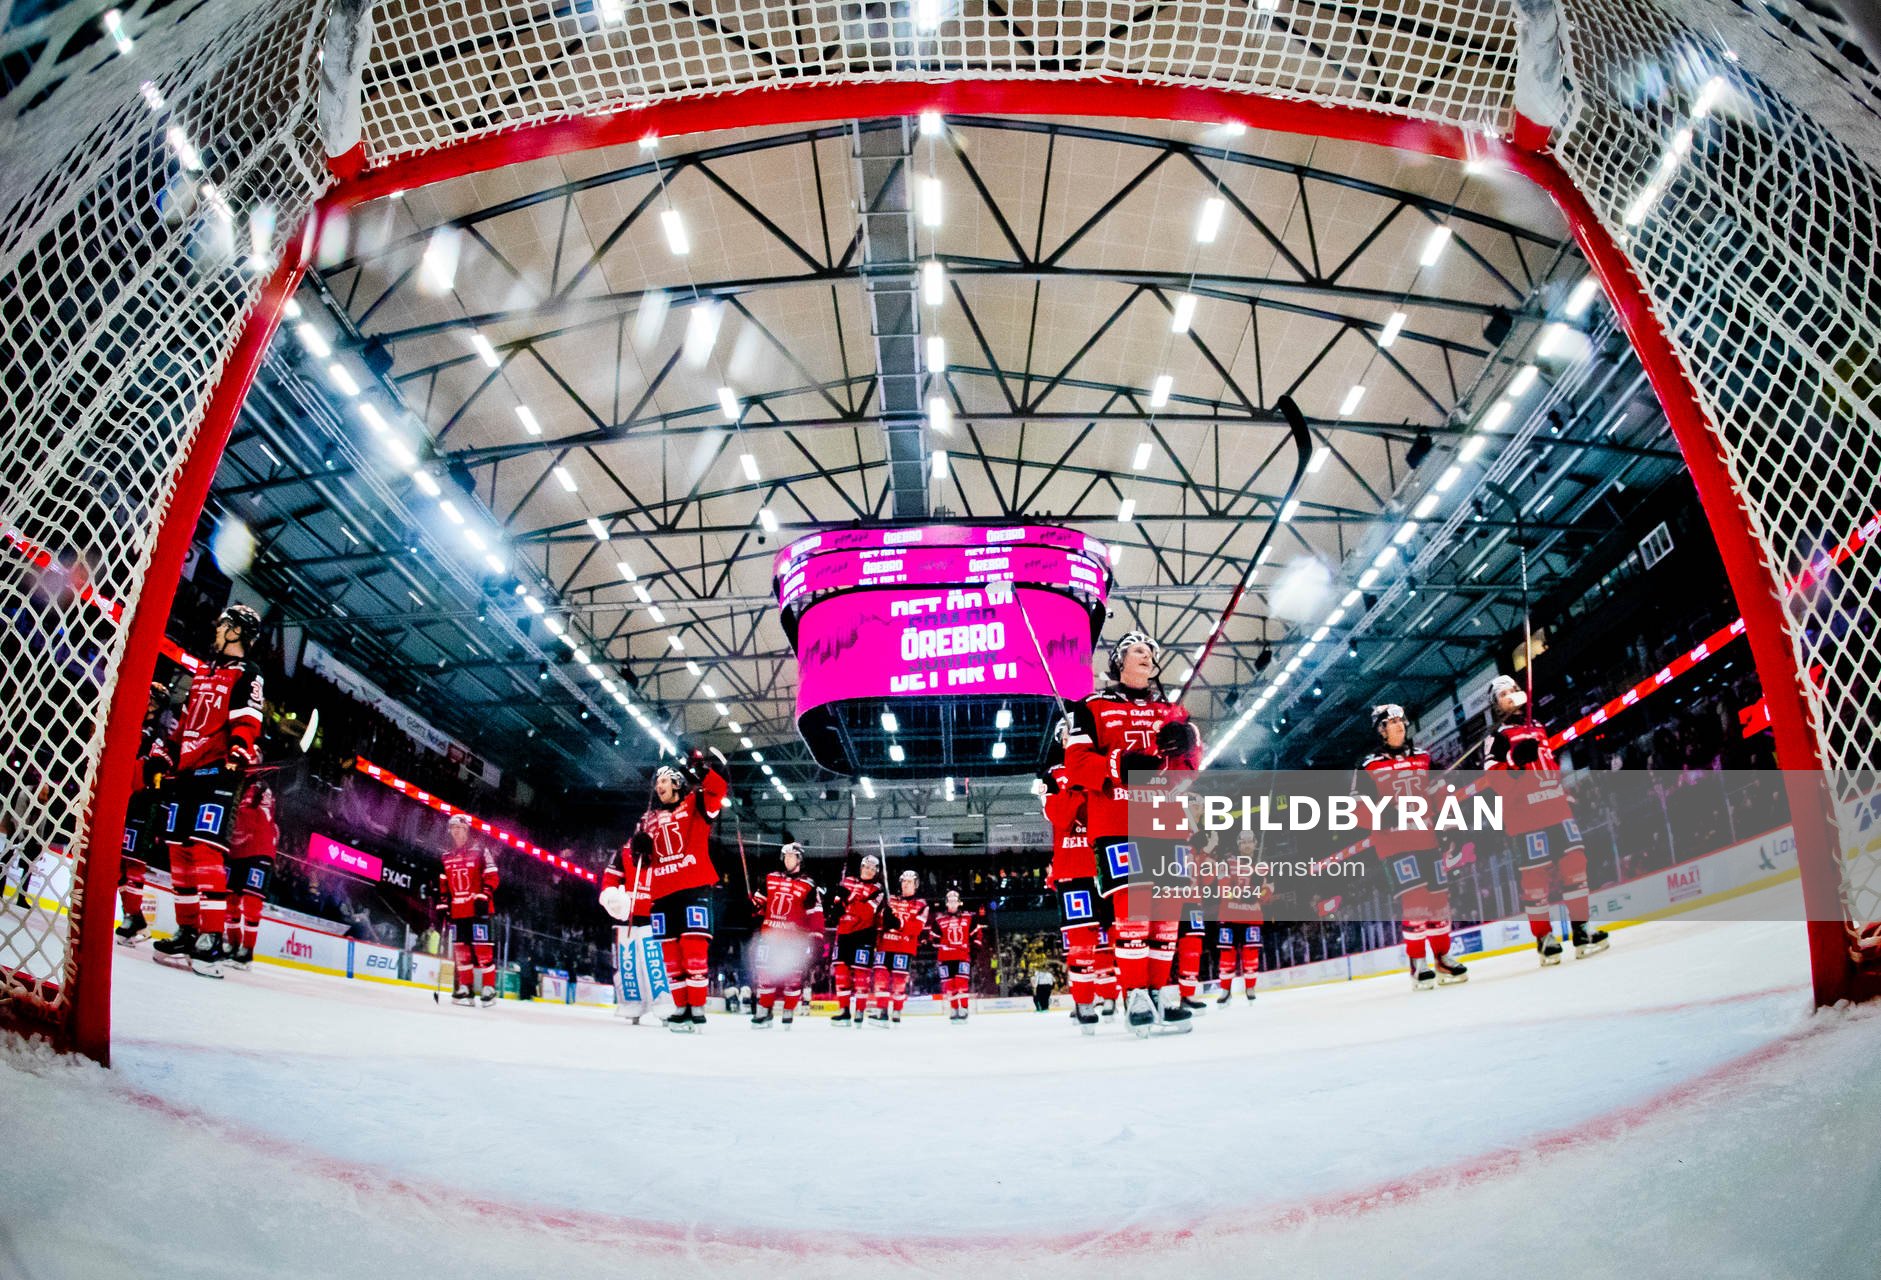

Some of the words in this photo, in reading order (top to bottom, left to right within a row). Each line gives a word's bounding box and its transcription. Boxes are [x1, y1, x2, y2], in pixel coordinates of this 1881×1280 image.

[901, 622, 1006, 661] ÖREBRO
[383, 867, 412, 888] EXACT
[645, 939, 666, 991] HEROK
